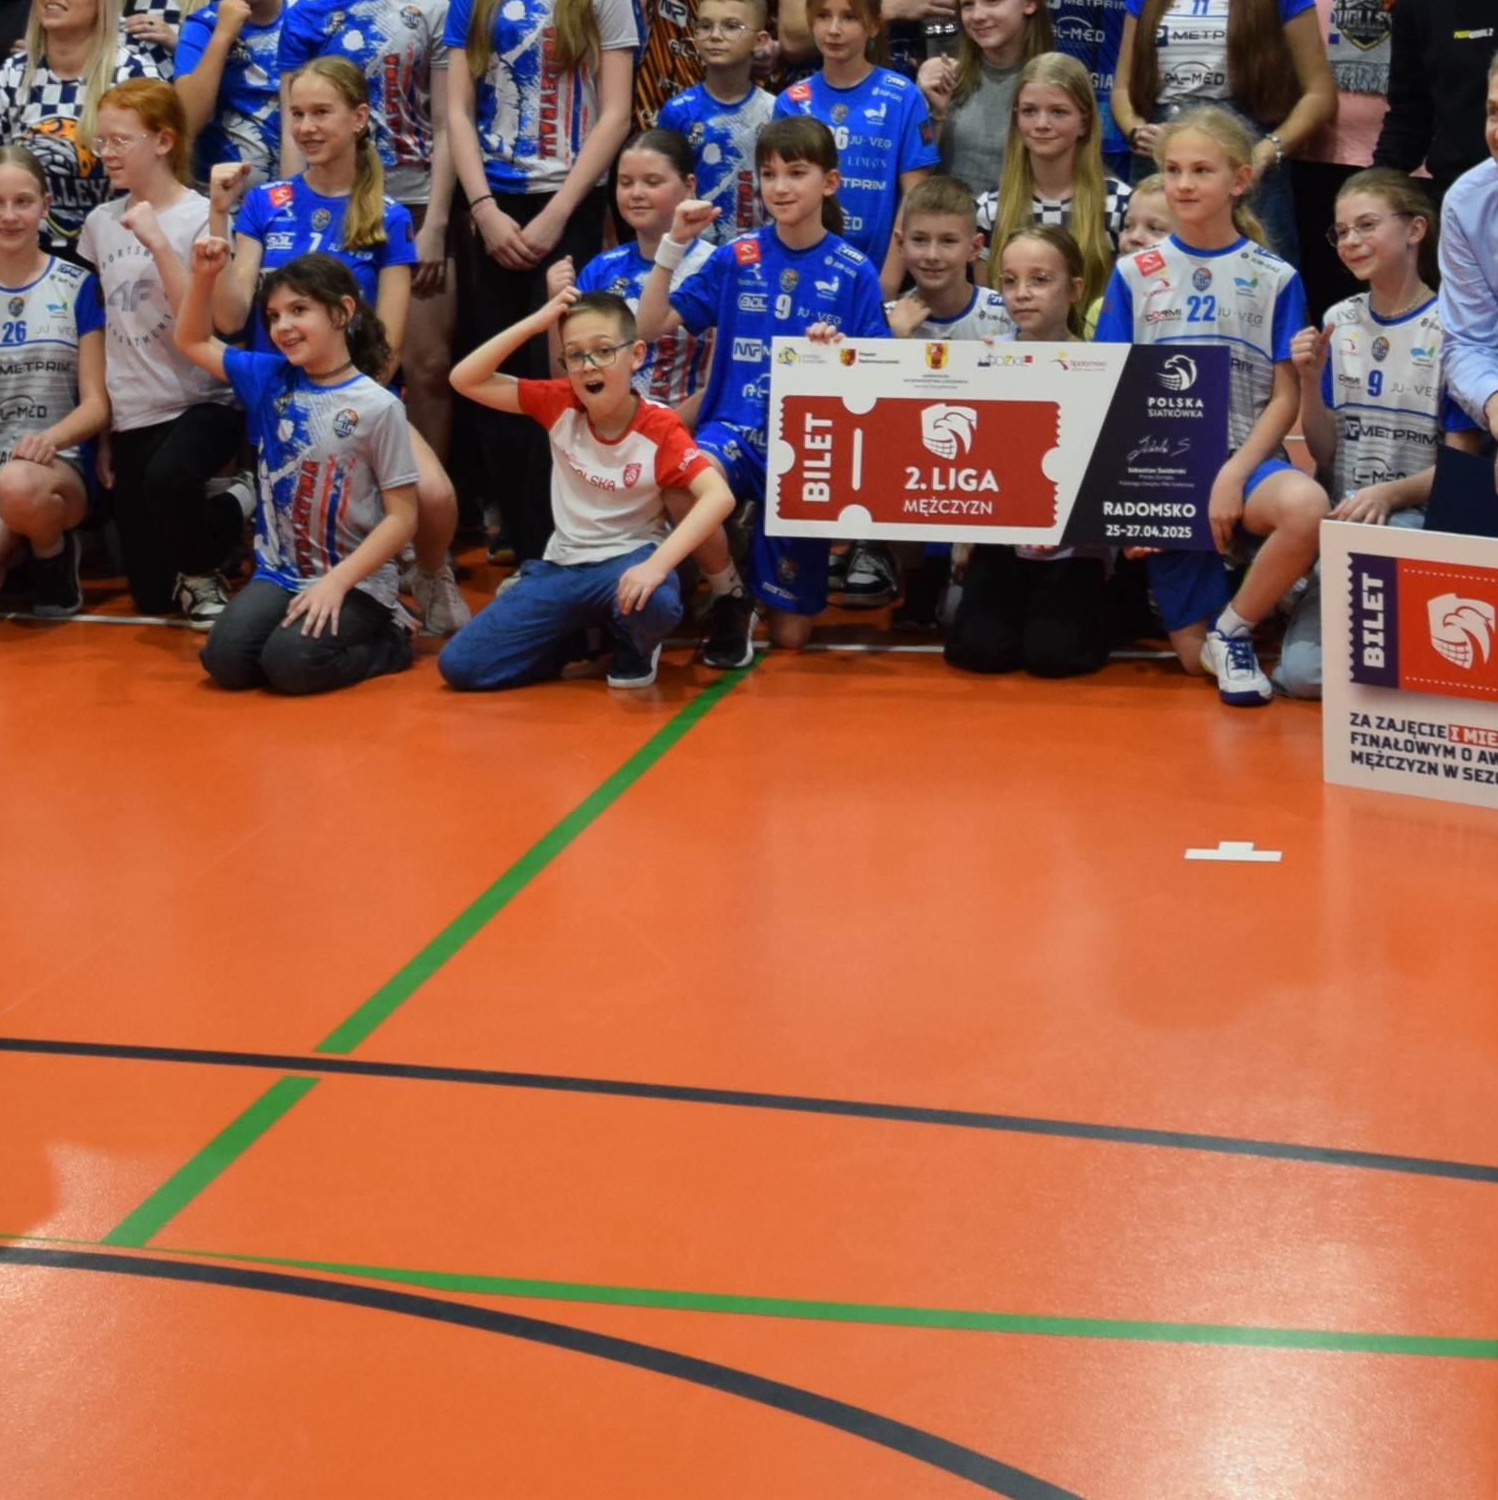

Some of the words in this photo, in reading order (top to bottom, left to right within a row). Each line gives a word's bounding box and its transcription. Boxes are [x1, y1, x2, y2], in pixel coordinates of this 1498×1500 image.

[1172, 30, 1226, 40] METP
[1164, 72, 1225, 86] AL-MED
[849, 135, 863, 145] JU
[869, 138, 892, 149] VEG
[309, 232, 323, 253] 7
[774, 294, 792, 320] 9
[797, 307, 810, 318] JU
[817, 312, 842, 326] VEG
[1186, 295, 1216, 323] 22
[1238, 311, 1263, 325] VEG
[1, 320, 27, 344] 26
[36, 325, 49, 335] JU
[1367, 369, 1384, 398] 9
[1390, 382, 1405, 393] JU
[1147, 397, 1204, 408] POLSKA
[1147, 408, 1204, 418] SIATKÓWKA
[802, 412, 833, 502] BILET
[576, 469, 616, 492] OLSKA
[932, 466, 1000, 492] LIGA
[903, 496, 993, 517] MĘŻCZYZN
[1103, 501, 1197, 518] RADOMSKO
[1105, 523, 1192, 538] 25-27.04.2025
[1361, 572, 1385, 669] BILET
[1350, 711, 1372, 729] ZA
[1375, 715, 1447, 739] ZAJĘCIE
[1450, 726, 1461, 741] I
[1350, 731, 1456, 760] FINAŁOWYM
[1461, 747, 1472, 762] O
[1350, 748, 1442, 776] MĘŻCZYZN
[1442, 763, 1459, 779] W
